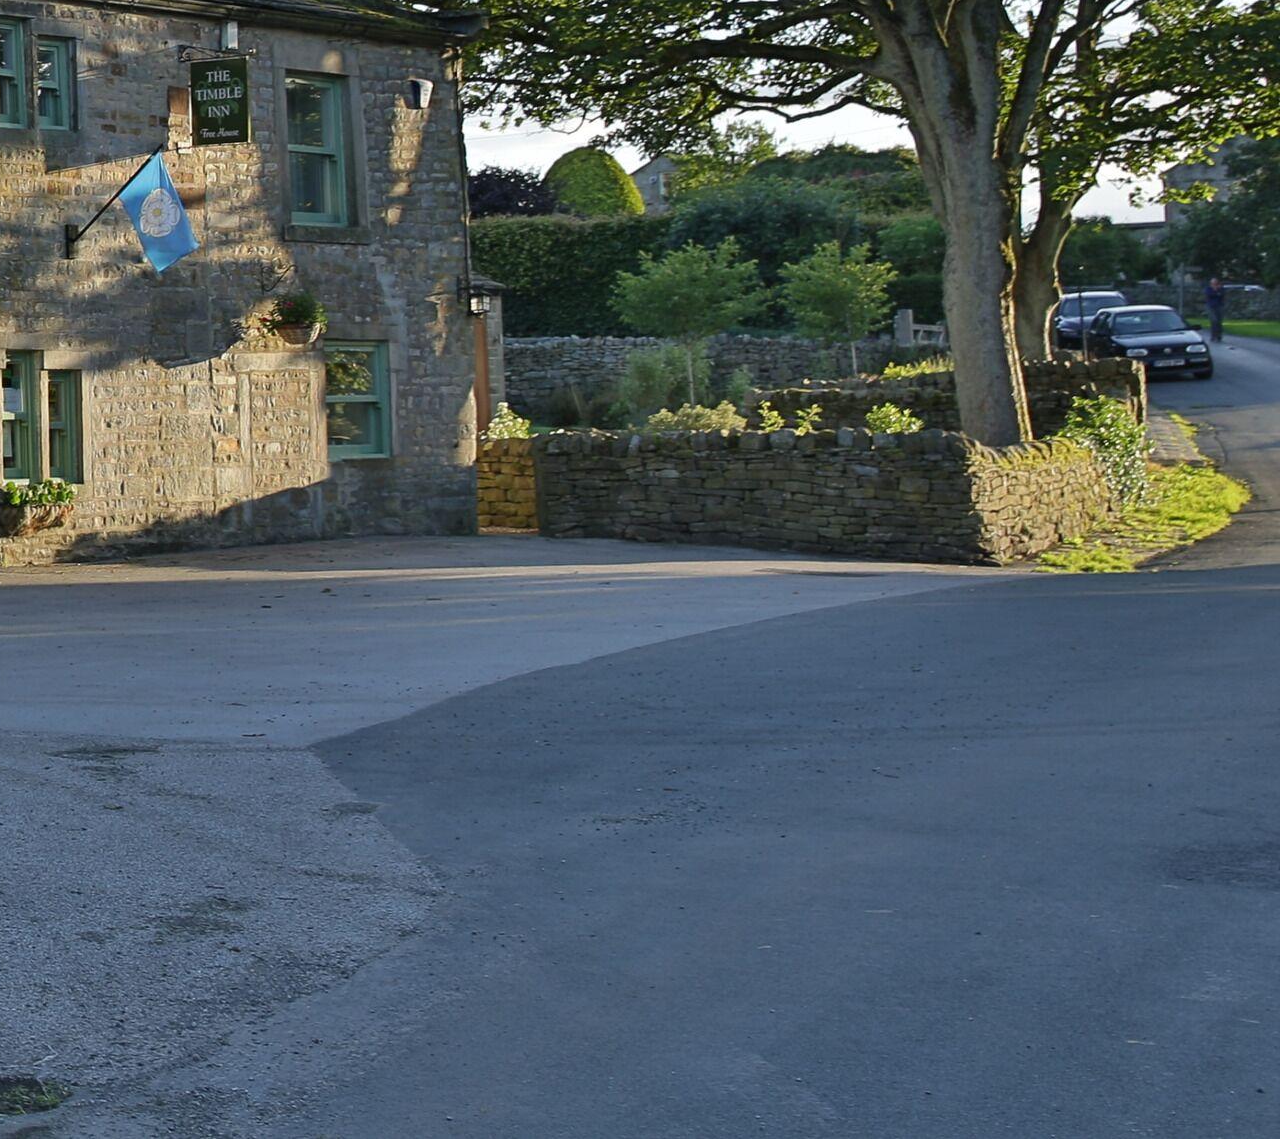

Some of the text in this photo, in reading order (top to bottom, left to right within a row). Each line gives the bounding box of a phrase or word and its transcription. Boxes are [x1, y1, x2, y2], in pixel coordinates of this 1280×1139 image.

[205, 70, 231, 83] THE
[195, 86, 243, 102] TIMBLE
[208, 105, 230, 118] INN
